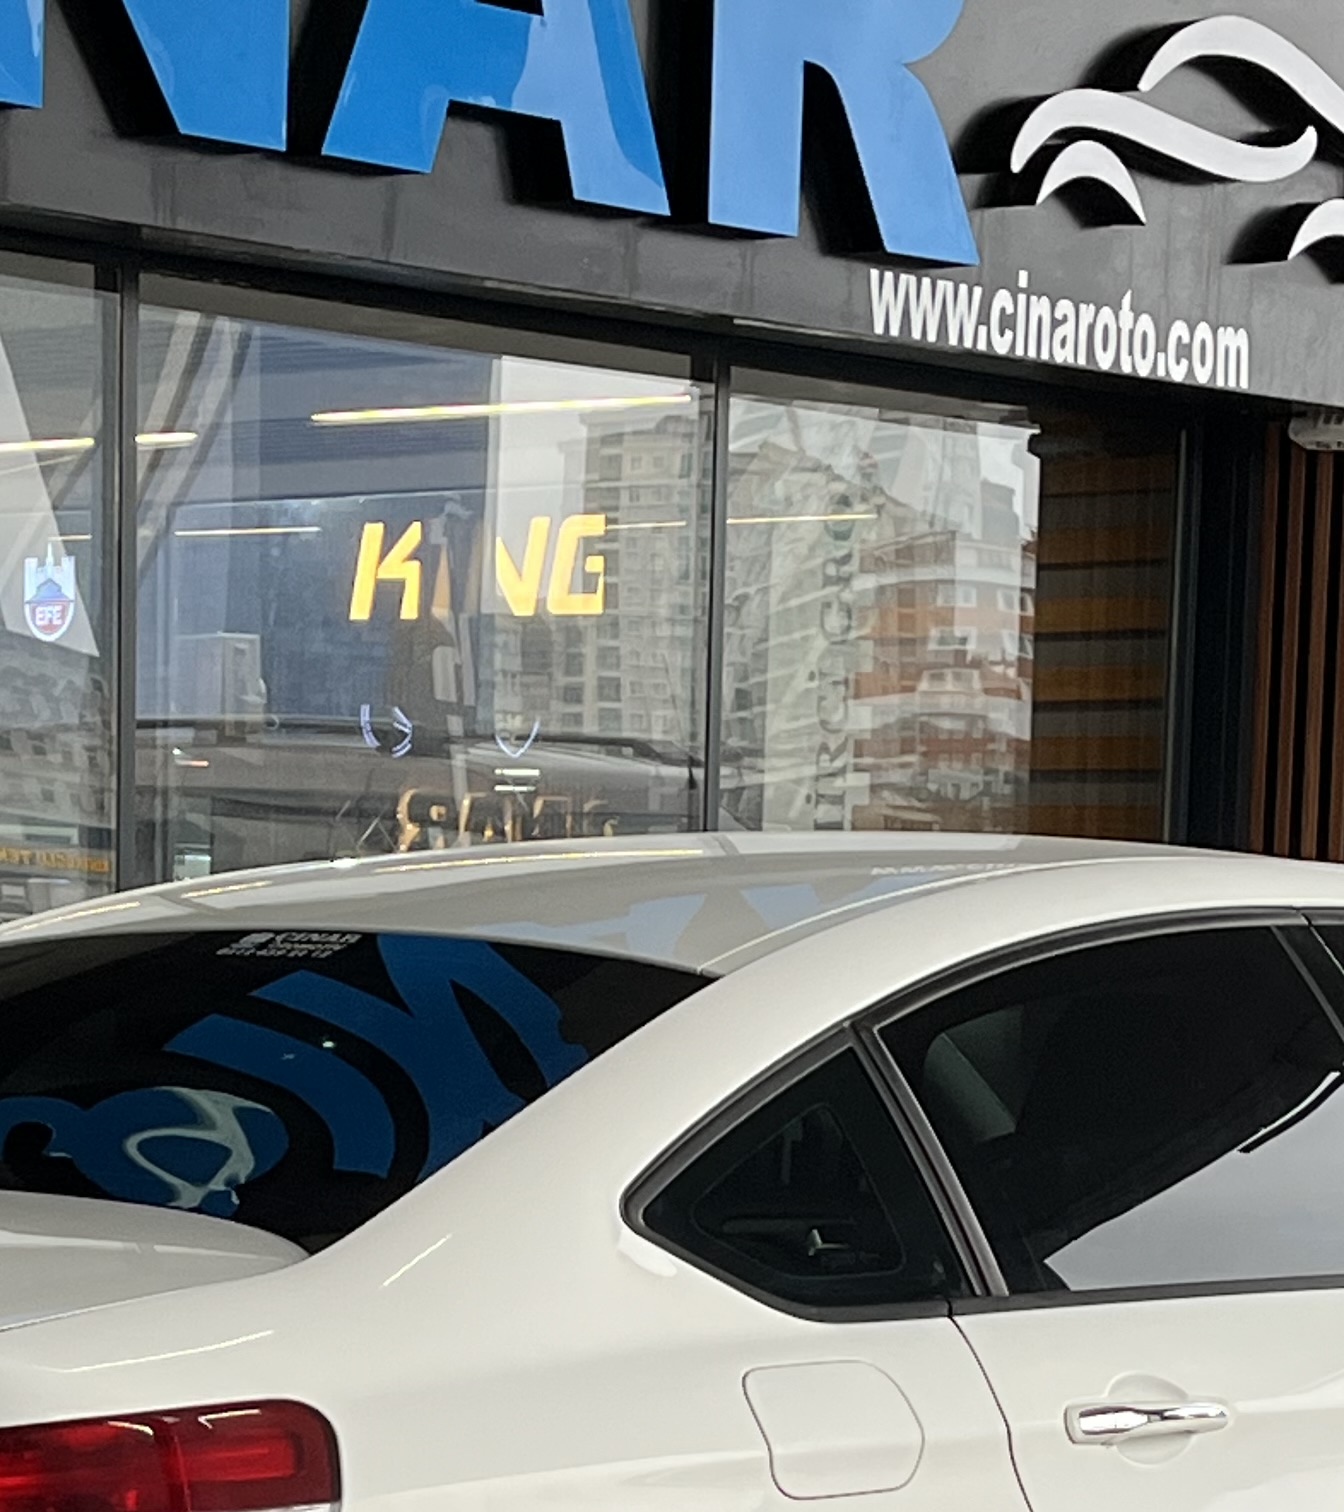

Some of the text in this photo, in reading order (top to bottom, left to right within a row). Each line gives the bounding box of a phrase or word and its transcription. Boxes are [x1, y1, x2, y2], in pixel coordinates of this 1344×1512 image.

[869, 269, 1250, 389] www.cinaroto.com
[35, 605, 64, 625] EFE
[349, 514, 606, 621] KNG
